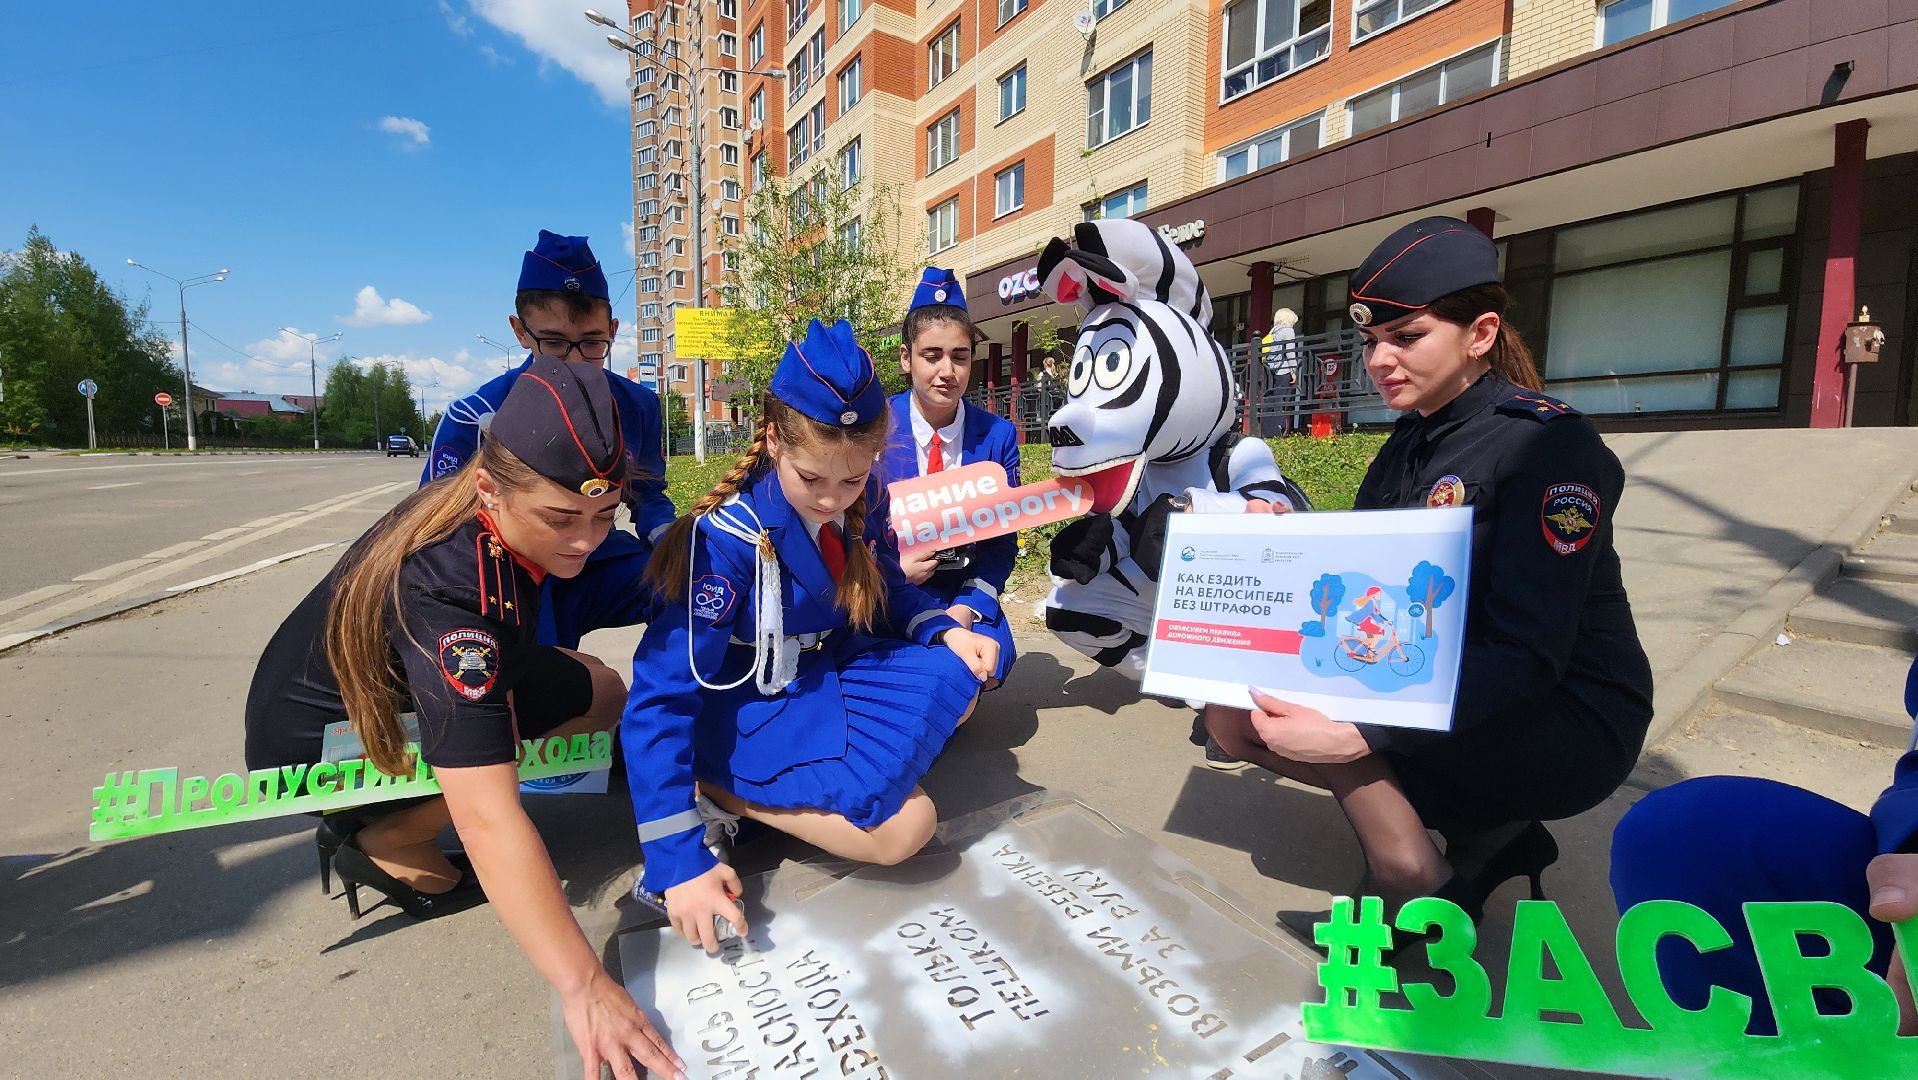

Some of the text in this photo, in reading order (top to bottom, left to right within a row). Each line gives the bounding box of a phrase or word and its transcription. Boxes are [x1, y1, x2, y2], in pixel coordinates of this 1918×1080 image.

[1549, 484, 1598, 506] ПОЛИЦИЯ
[1553, 496, 1593, 515] РОССИЯ
[1553, 539, 1576, 554] МВД
[702, 582, 725, 596] ЮИД
[1177, 572, 1262, 587] КАК ЕЗДИТЬ
[1175, 585, 1294, 604] НА ВЕЛОСИПЕДЕ
[1173, 598, 1272, 616] БЕЗ ШТРАФОВ
[442, 632, 498, 649] ПОЛИЦИЯ
[1167, 632, 1252, 646] ДОРОЖНОГО ДВИЖЕНИЯ
[1209, 628, 1242, 637] ПРАВИЛА
[1064, 869, 1186, 960] ЗА РУКУ
[992, 843, 1228, 1040] ВОЗЬМИ РЕБЕНКА
[929, 907, 1051, 1022] ПЕШКОМ
[896, 922, 996, 1032] ТОЛЬКО
[1305, 895, 1918, 1060] #ЗАСВ
[686, 982, 724, 1005] В
